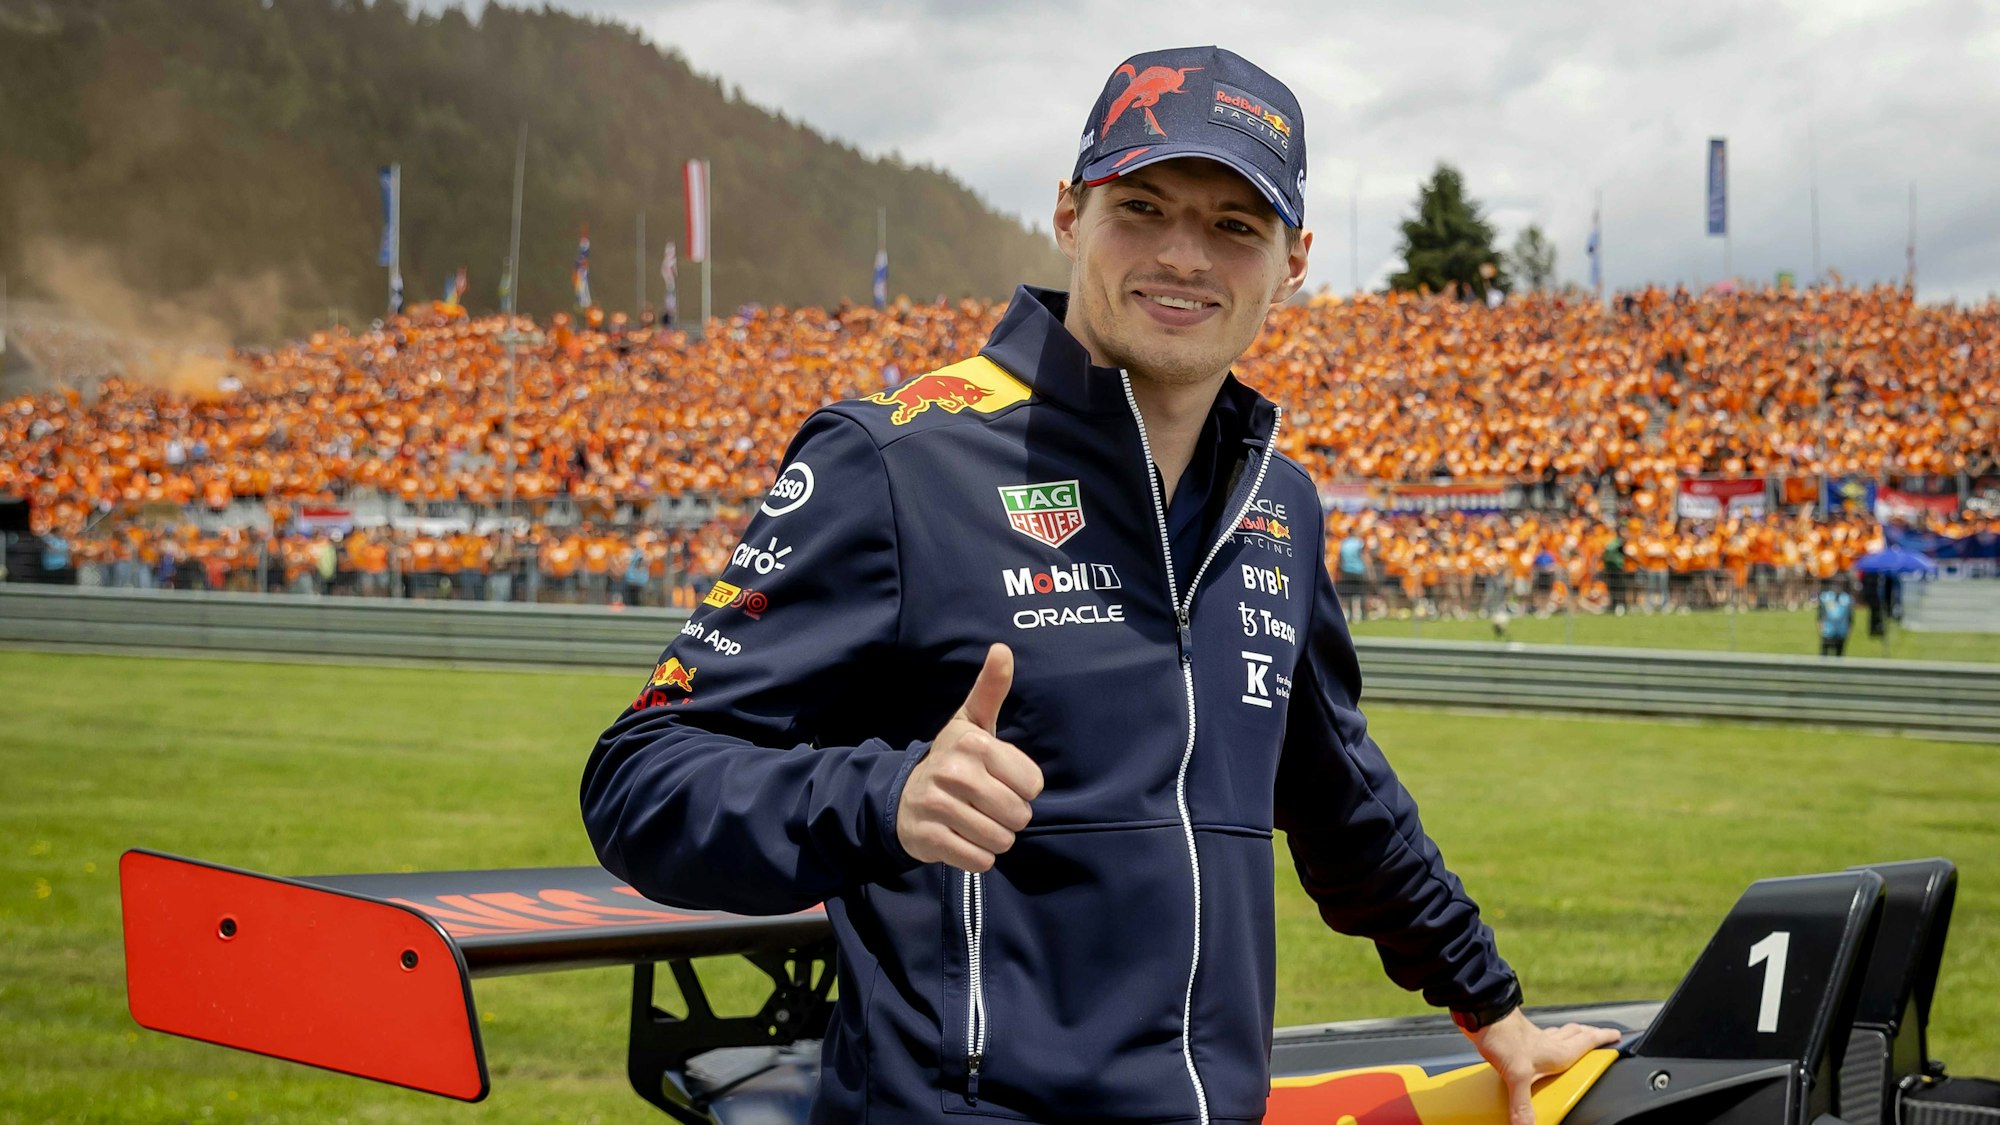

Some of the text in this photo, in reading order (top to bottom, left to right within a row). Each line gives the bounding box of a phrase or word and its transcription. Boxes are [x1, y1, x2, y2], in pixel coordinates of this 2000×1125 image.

[1214, 105, 1288, 149] RACING
[1006, 486, 1073, 510] TAG
[1248, 499, 1287, 520] ACLE
[1012, 511, 1080, 543] HEUER
[1002, 562, 1090, 597] Mobil
[1241, 564, 1290, 600] BYBIT
[1013, 604, 1125, 629] ORACLE
[1260, 609, 1296, 646] Tezos
[704, 629, 742, 656] App
[1747, 931, 1791, 1033] 1
